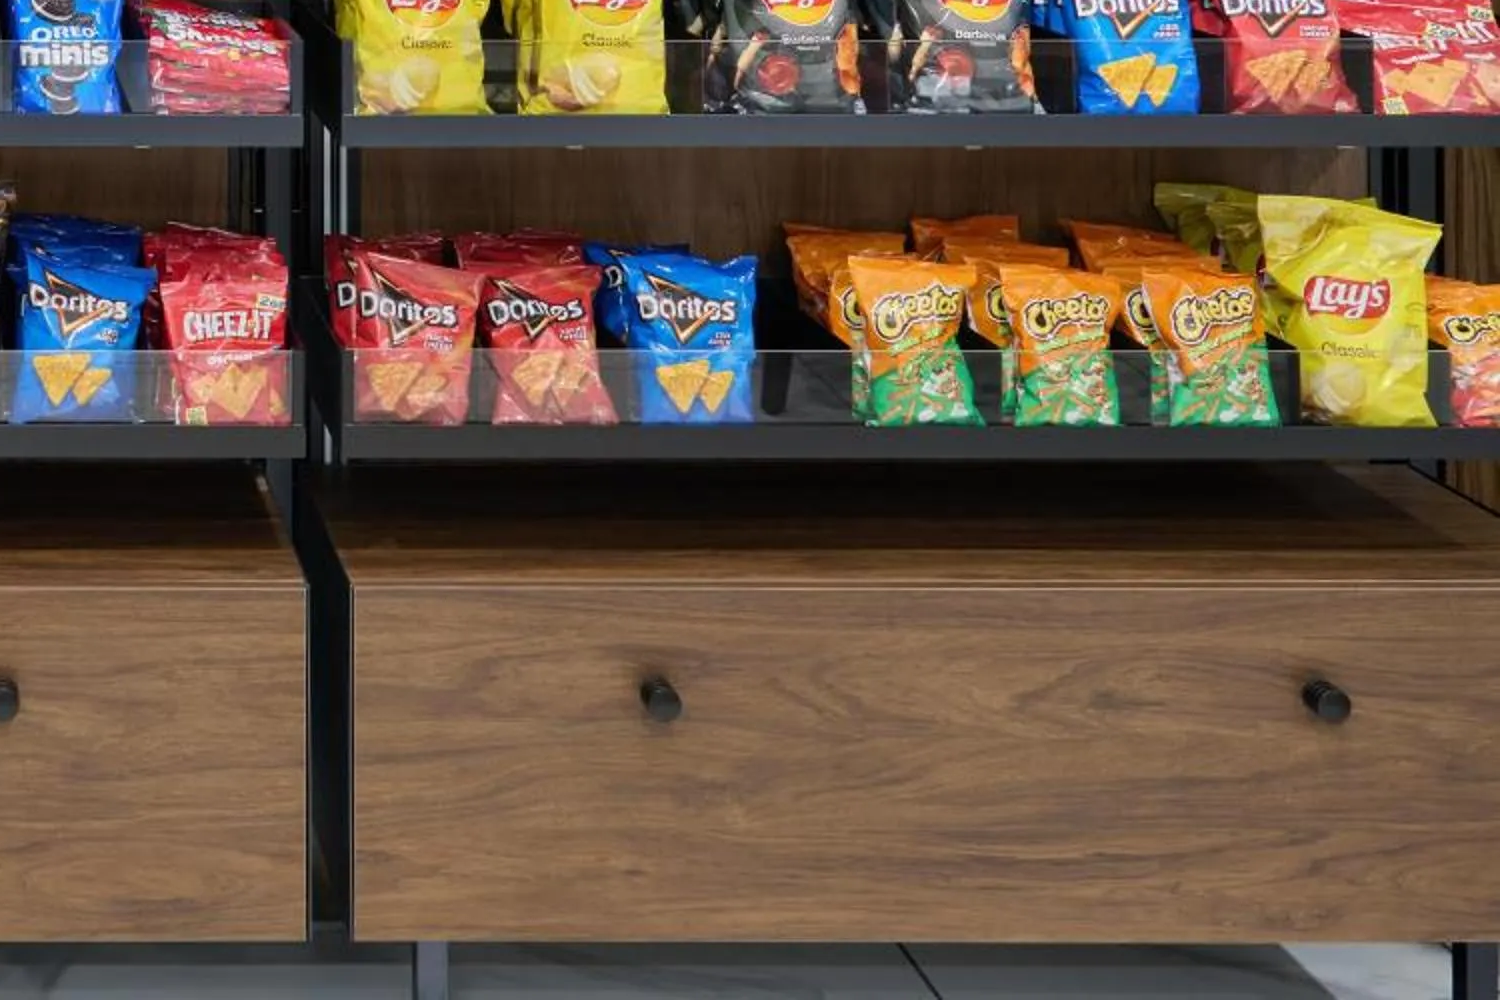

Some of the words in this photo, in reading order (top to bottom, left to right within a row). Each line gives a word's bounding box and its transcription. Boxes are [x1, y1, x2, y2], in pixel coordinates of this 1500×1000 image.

[20, 40, 108, 66] minis
[30, 283, 128, 320] Doritos
[361, 291, 457, 326] Doritos
[487, 300, 584, 325] Doritos
[637, 293, 736, 322] Doritos
[875, 285, 961, 341] Cheetos
[1172, 289, 1254, 344] Cheetos
[1309, 277, 1387, 319] Lay's
[1024, 295, 1110, 340] Cheetos
